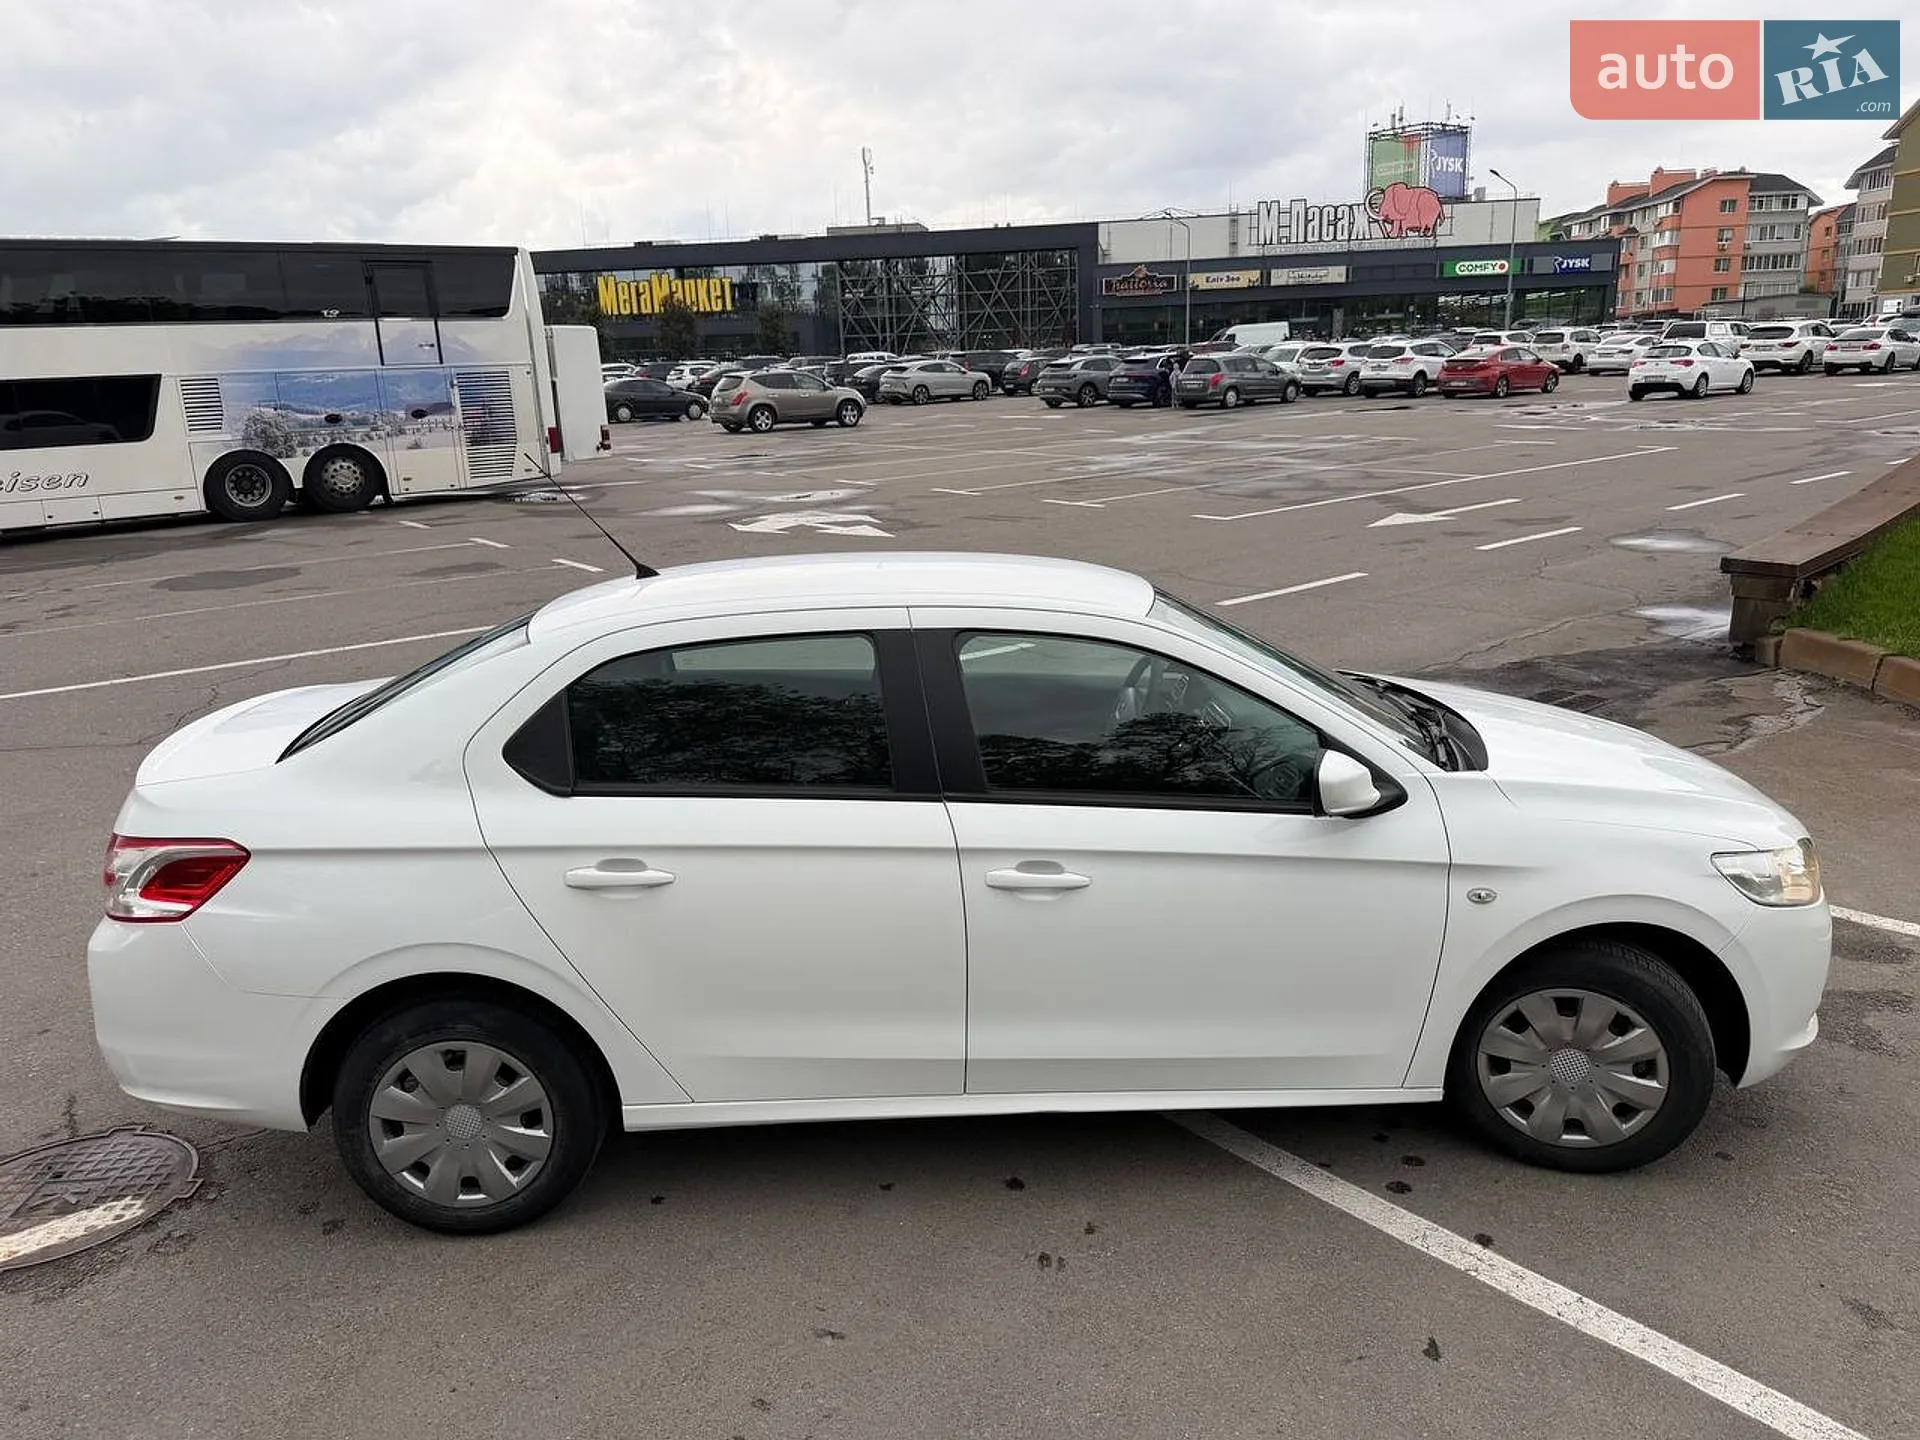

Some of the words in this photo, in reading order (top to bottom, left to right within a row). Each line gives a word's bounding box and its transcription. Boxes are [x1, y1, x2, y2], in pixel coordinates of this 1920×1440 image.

[1436, 156, 1464, 173] JYSK
[1458, 262, 1498, 273] COMFY
[1561, 257, 1590, 269] JYSK
[0, 471, 88, 493] isen
